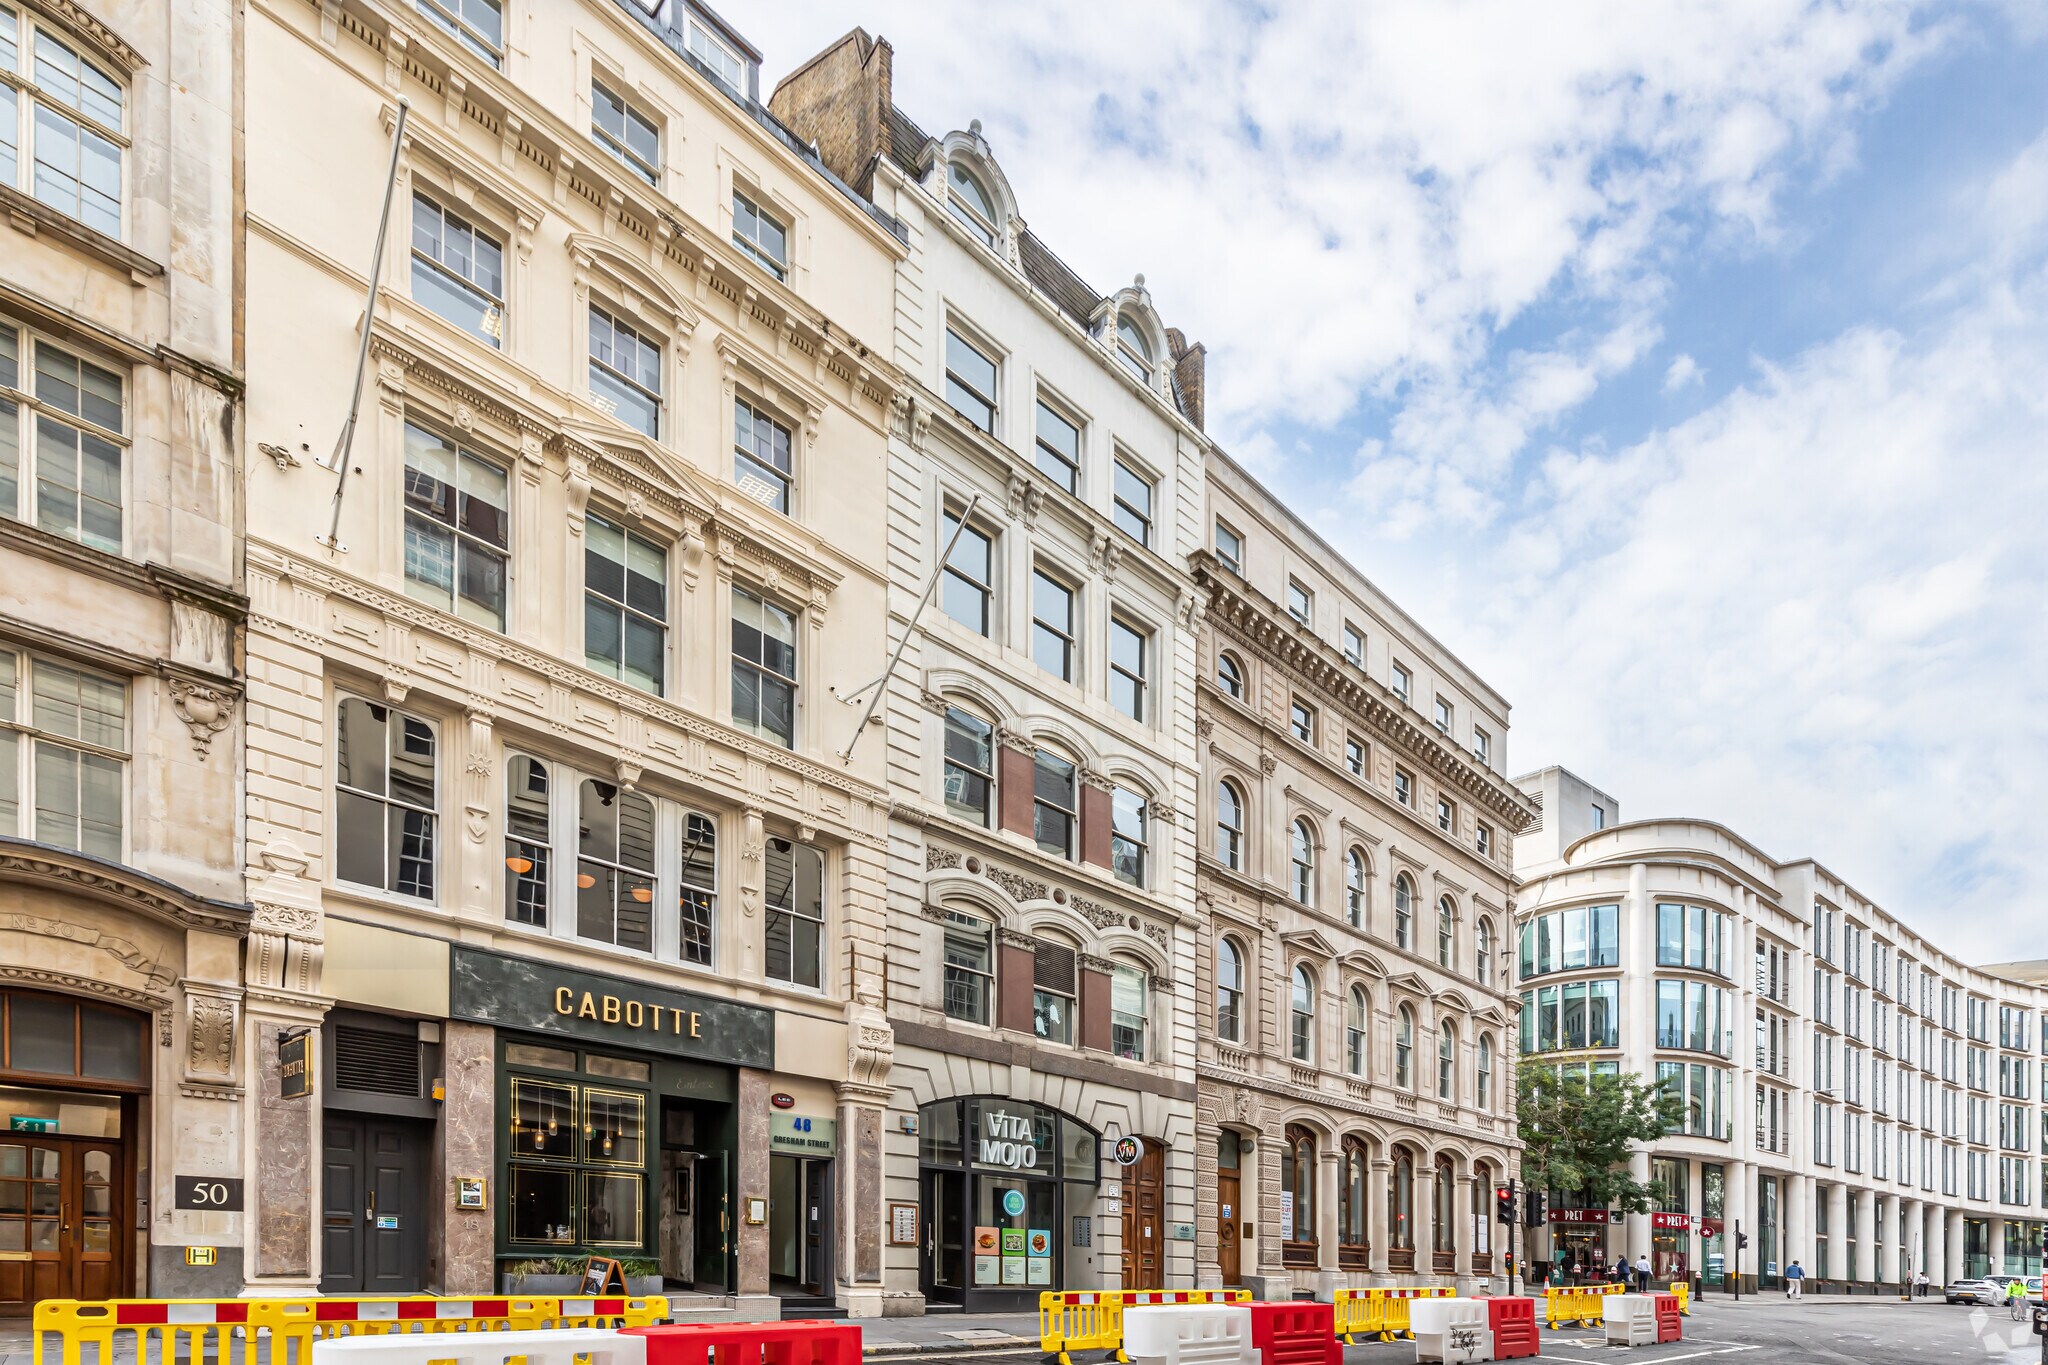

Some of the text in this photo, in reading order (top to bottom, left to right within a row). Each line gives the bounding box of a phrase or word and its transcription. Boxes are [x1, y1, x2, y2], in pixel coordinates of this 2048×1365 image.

[43, 921, 75, 937] 50
[555, 986, 702, 1038] CABOTTE
[793, 1117, 811, 1132] 48
[773, 1135, 830, 1148] GRESHAM STREET
[980, 1139, 1037, 1170] MOJO
[192, 1183, 228, 1205] 50
[1564, 1210, 1584, 1221] PRET
[1666, 1215, 1682, 1227] PRET
[192, 1249, 210, 1263] H
